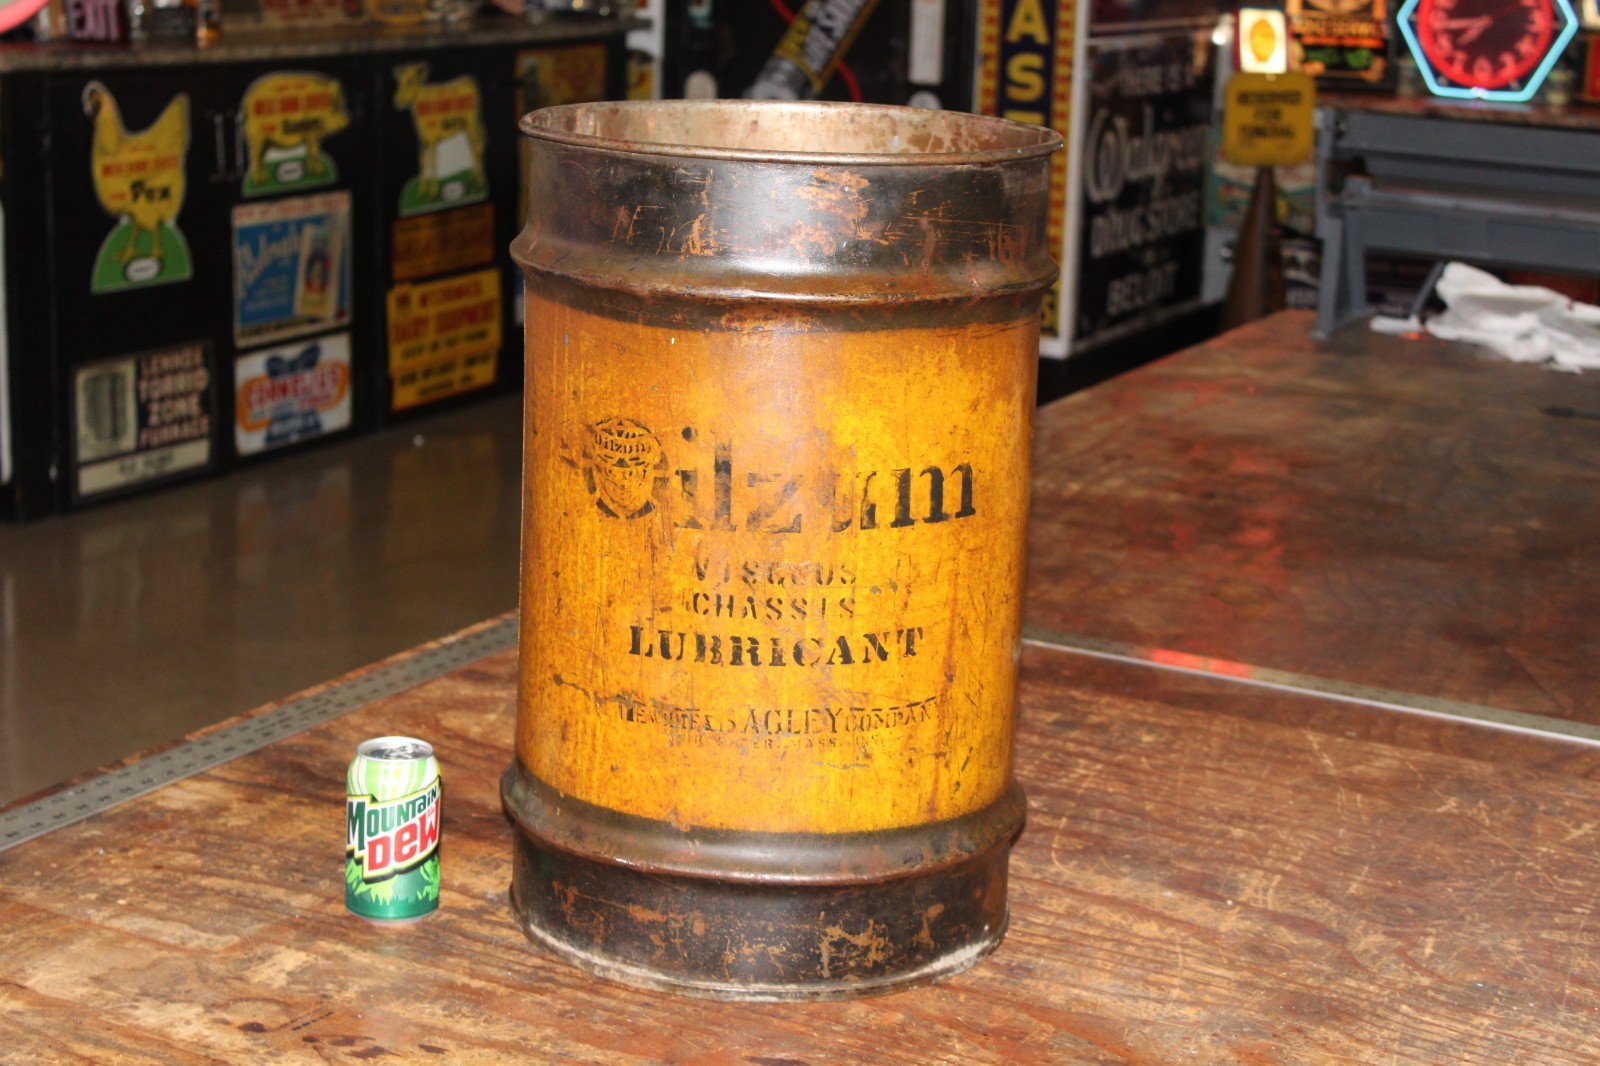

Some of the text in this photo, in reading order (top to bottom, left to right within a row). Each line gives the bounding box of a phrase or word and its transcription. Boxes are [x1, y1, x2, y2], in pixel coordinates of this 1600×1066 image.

[694, 556, 857, 586] VISCOUS
[691, 591, 856, 622] CHASSIS
[628, 624, 925, 667] LUBRICANT
